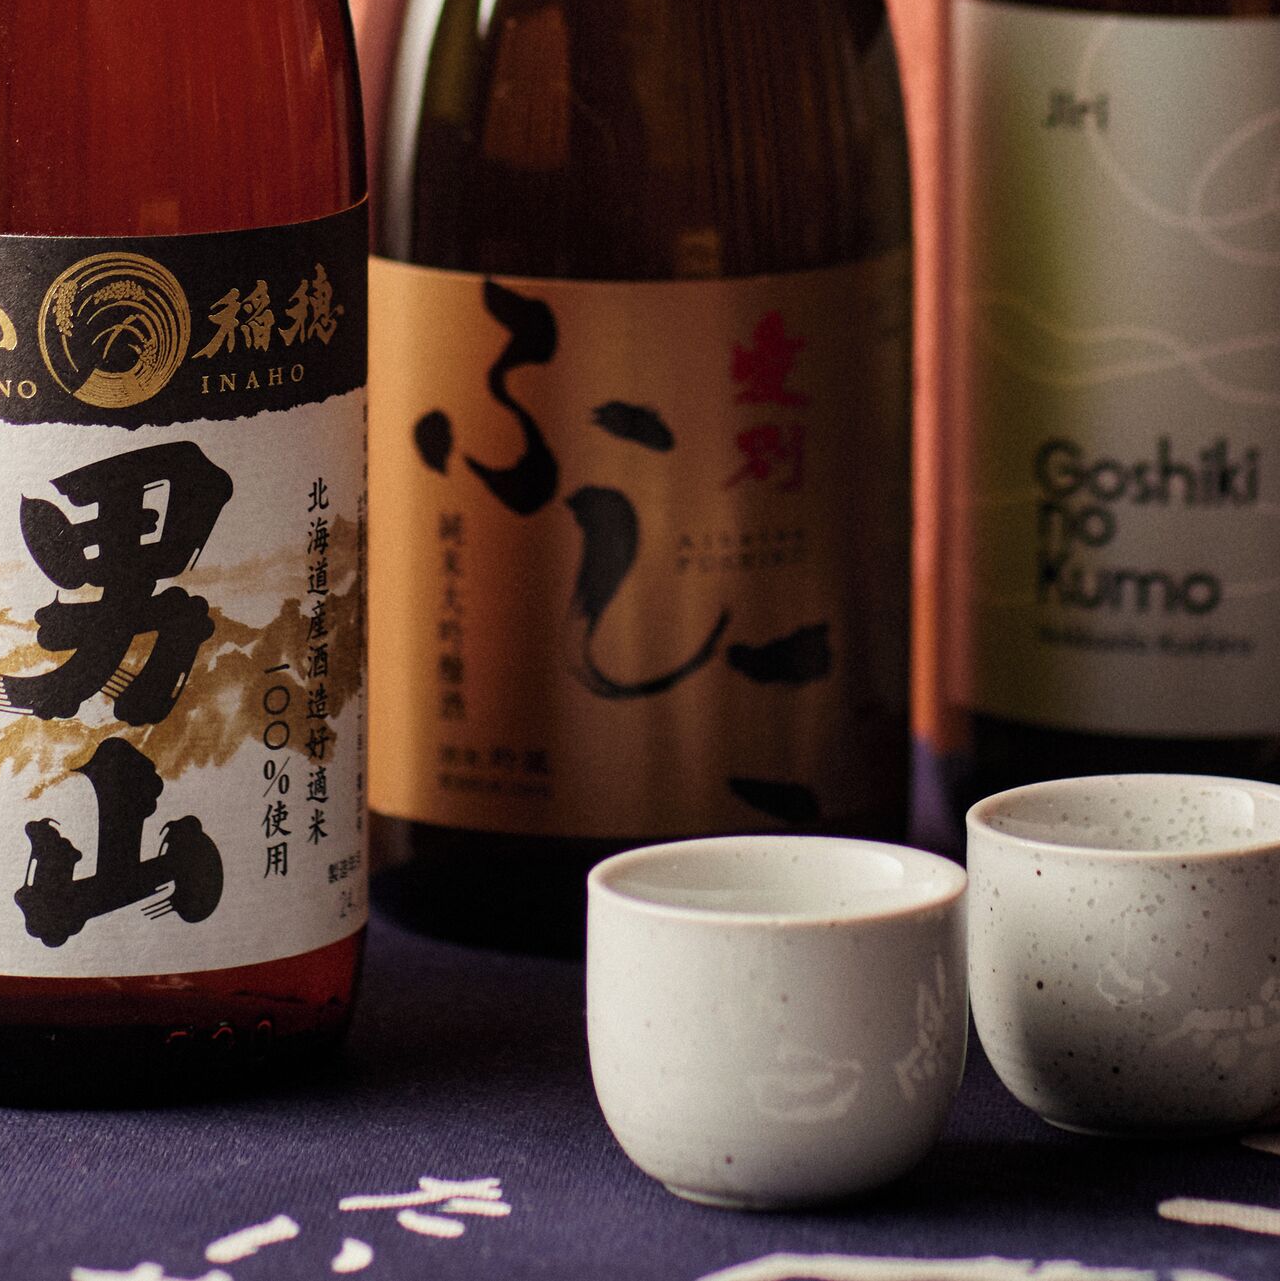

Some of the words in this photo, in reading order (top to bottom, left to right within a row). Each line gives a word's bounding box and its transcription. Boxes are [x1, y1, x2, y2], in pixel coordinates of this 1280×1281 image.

[191, 263, 345, 360] 稲穂
[201, 363, 306, 394] INAHO
[1034, 434, 1259, 508] Goshiki
[1036, 550, 1222, 616] Kumo
[305, 477, 332, 846] 北海道産酒造好適米
